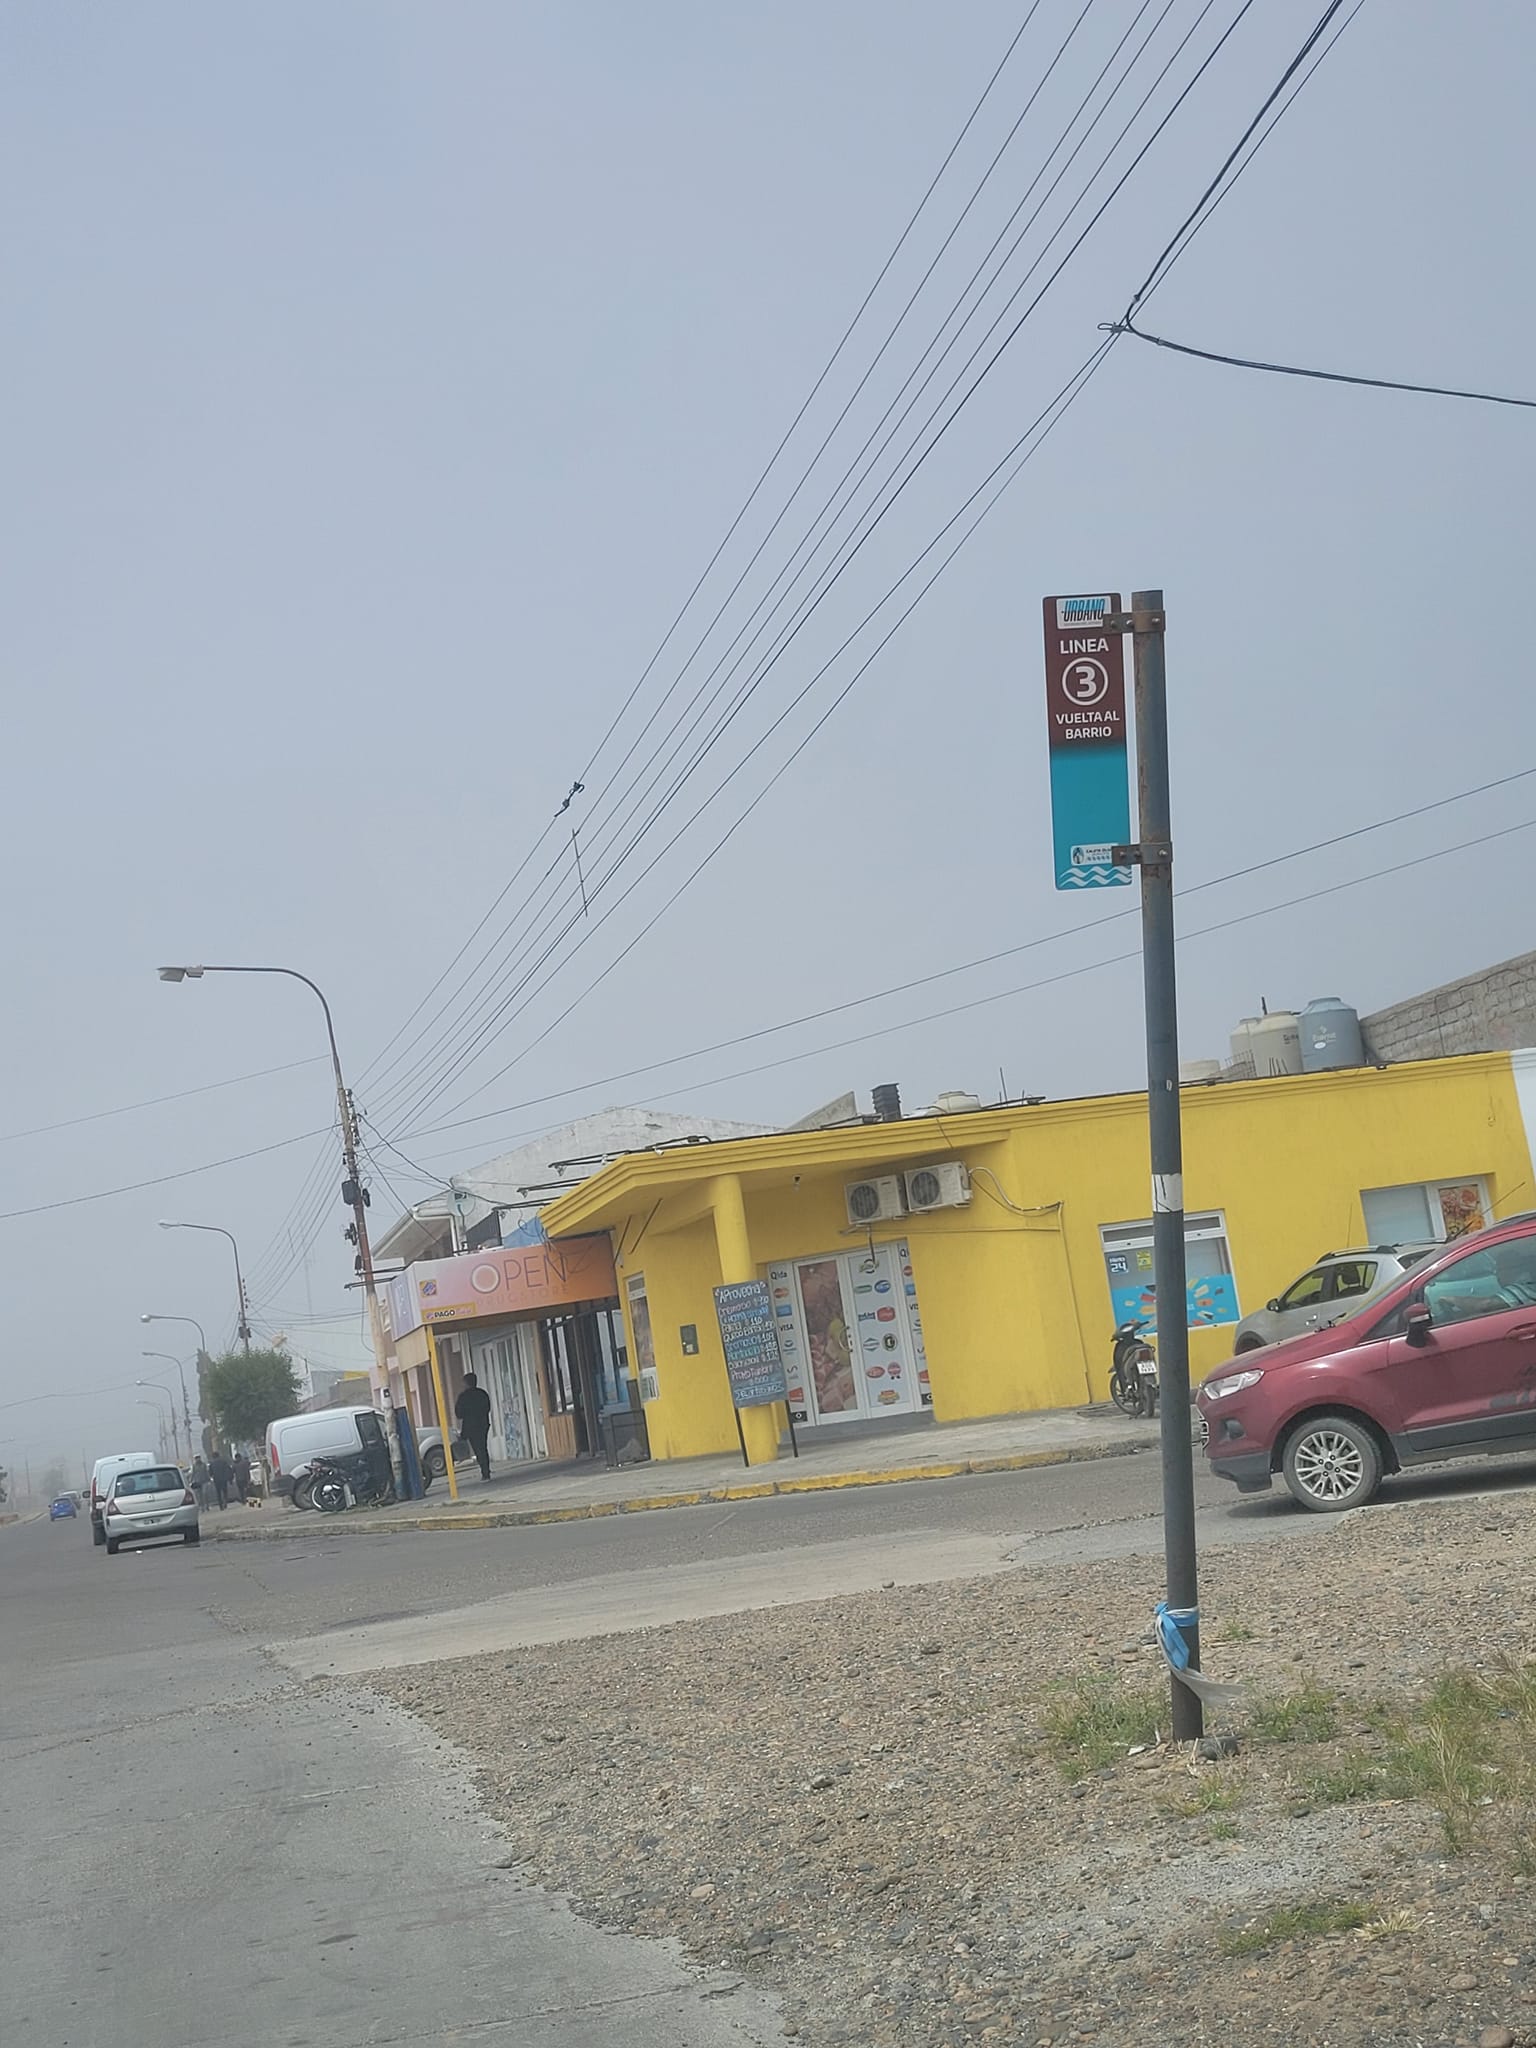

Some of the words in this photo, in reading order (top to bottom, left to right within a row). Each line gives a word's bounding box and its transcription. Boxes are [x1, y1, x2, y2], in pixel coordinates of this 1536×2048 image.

[1063, 599, 1105, 622] URBANO
[1060, 638, 1109, 654] LINEA
[1075, 666, 1097, 698] 3
[1055, 711, 1103, 725] VUELTA
[1104, 710, 1120, 722] AL
[1065, 726, 1112, 740] BARRIO
[471, 1254, 567, 1294] OPEN
[1110, 1262, 1126, 1273] 24
[434, 1309, 456, 1318] PAGO
